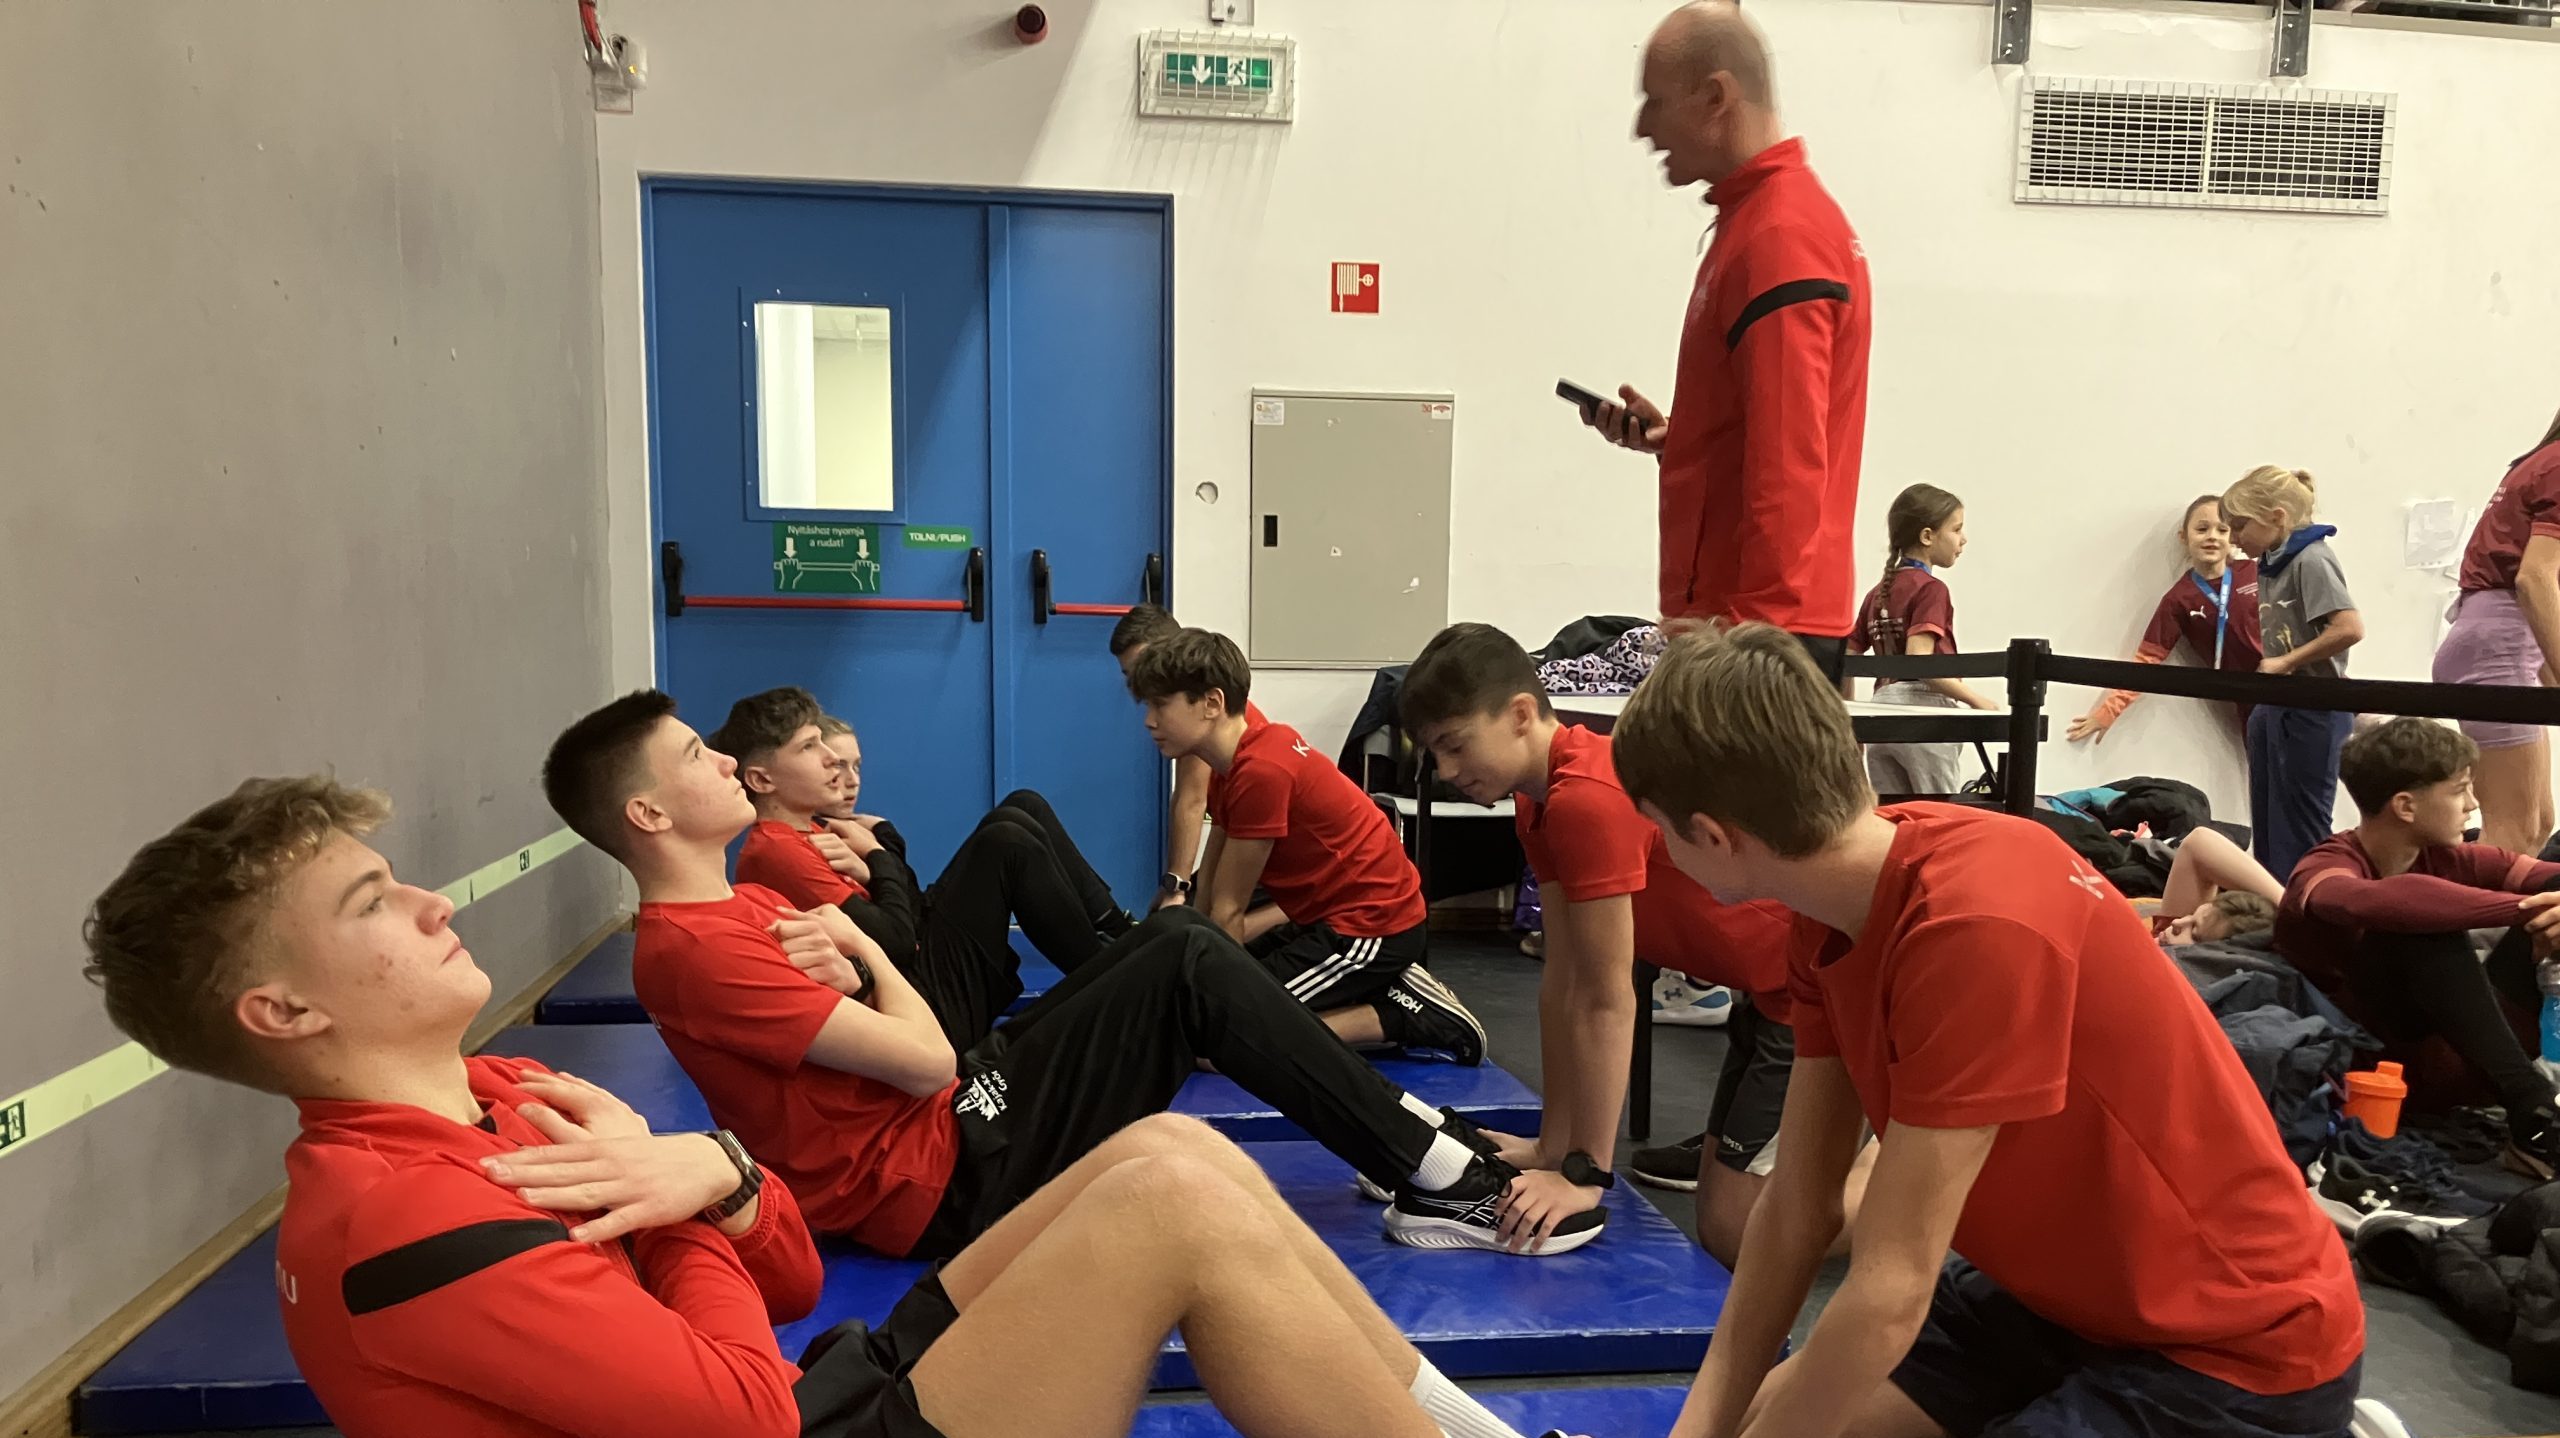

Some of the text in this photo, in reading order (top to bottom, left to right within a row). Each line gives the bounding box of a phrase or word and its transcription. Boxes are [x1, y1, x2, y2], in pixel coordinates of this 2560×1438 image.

[832, 527, 864, 536] nyomja
[817, 538, 844, 547] rudat!
[1388, 986, 1423, 1013] HOKA
